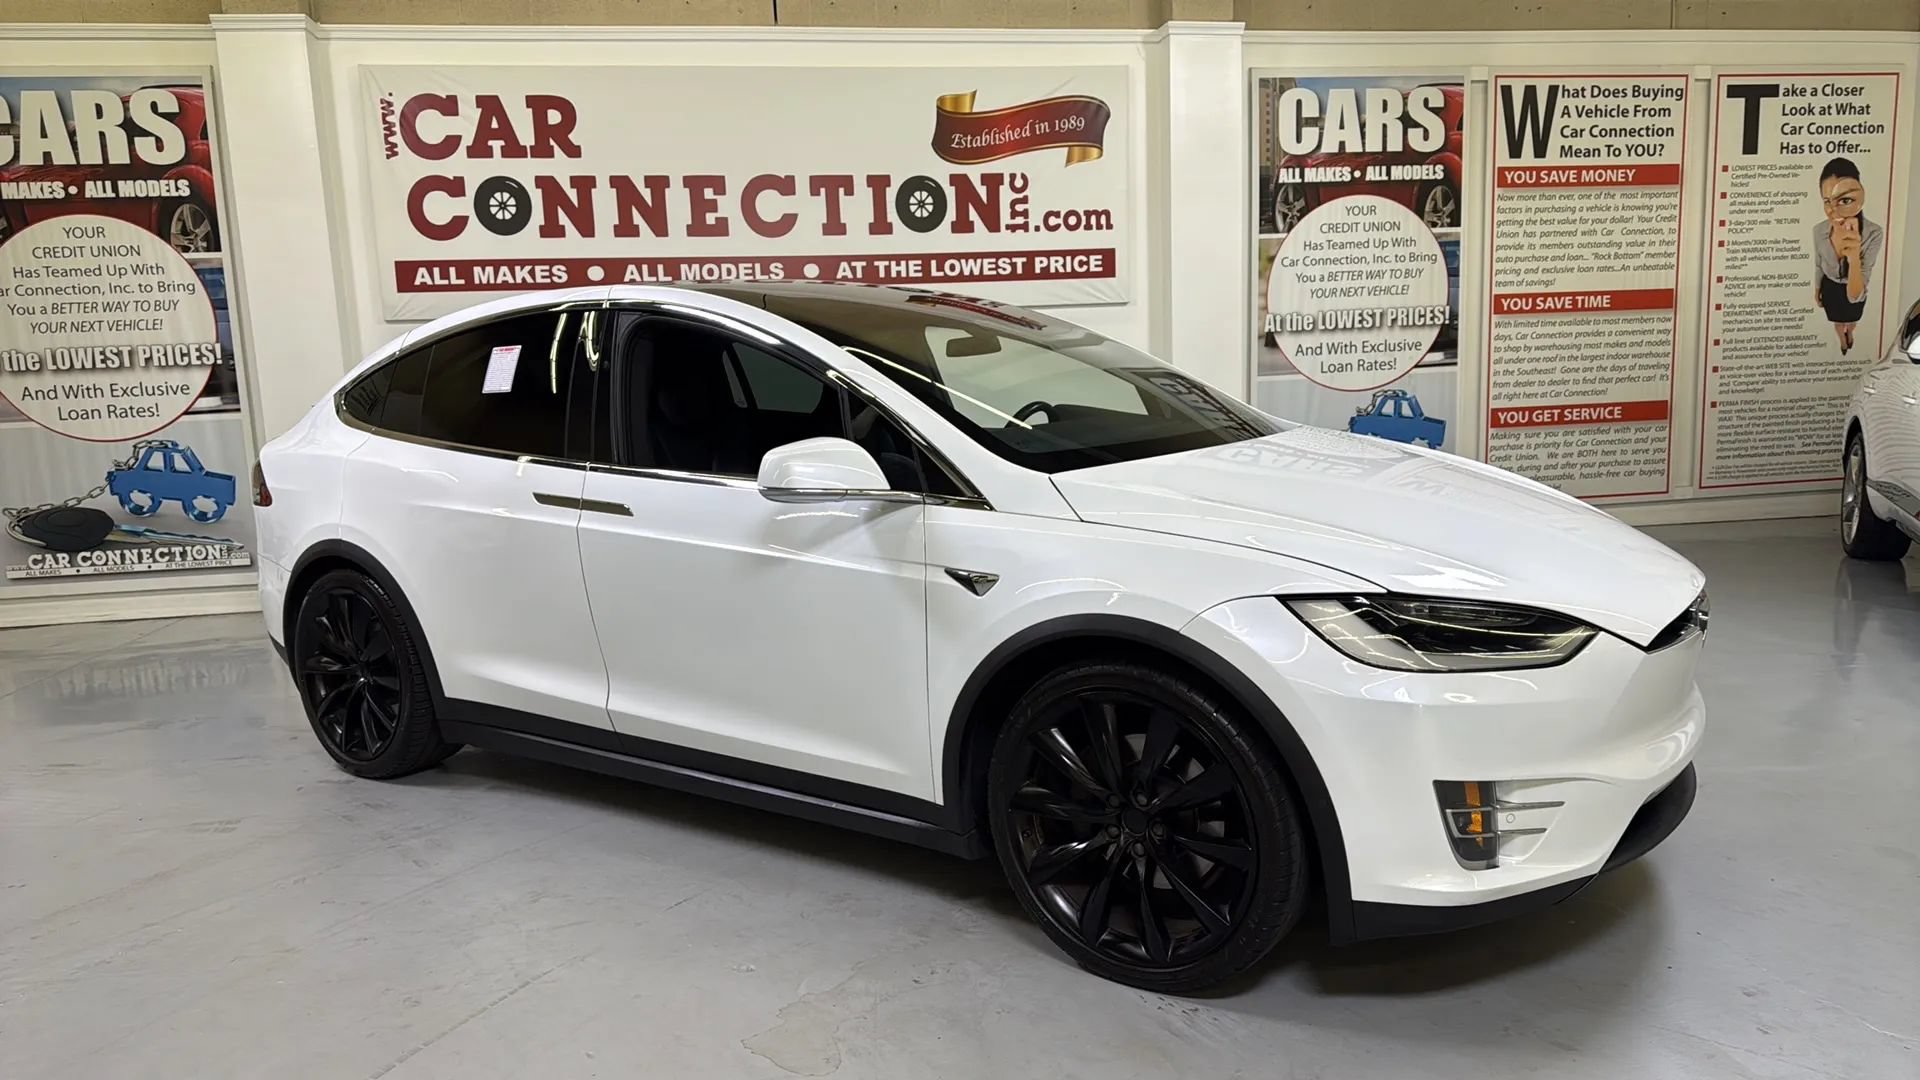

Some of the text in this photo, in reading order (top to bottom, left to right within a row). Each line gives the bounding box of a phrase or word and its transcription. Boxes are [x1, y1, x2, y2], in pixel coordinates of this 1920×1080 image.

[1590, 85, 1627, 98] Does
[1632, 84, 1684, 101] Buying
[1810, 88, 1818, 97] a
[1822, 84, 1864, 96] Closer
[1560, 105, 1671, 118] A Vehicle From
[1782, 102, 1871, 116] Look at What
[0, 88, 186, 166] ARS
[380, 92, 399, 160] www.
[399, 93, 582, 161] CAR
[1278, 87, 1445, 155] CARS
[1781, 121, 1884, 135] Car Connection
[951, 116, 1085, 148] Established in 1989
[1560, 124, 1674, 138] Car Connection
[1560, 143, 1664, 158] Mean To YOU?
[1780, 140, 1871, 155] Has to Offer...
[1279, 167, 1351, 183] ALL MAKES
[1365, 165, 1444, 181] ALL MODELS
[1504, 169, 1636, 183] YOU SAVE MONEY
[1, 180, 190, 199] MAKES ALL MODELS
[406, 173, 1004, 242] CONNECTION
[1345, 206, 1377, 216] YOUR
[1034, 208, 1113, 232] .com
[1320, 221, 1401, 233] CREDIT UNION
[62, 227, 105, 238] YOUR
[32, 245, 141, 259] CREDIT UNION
[1304, 237, 1416, 251] Has Teamed Up With
[836, 254, 1103, 279] AT THE LOWEST PRICE
[1281, 252, 1437, 267] Car Connection, Inc. to Bring
[13, 264, 164, 279] Has Teamed Up With
[414, 265, 568, 286] ALL MAKES
[623, 262, 784, 282] ALL MODELS
[1296, 273, 1316, 283] You
[1327, 271, 1363, 281] BETTER
[1365, 270, 1387, 280] WAY
[1390, 269, 1402, 279] TO
[1404, 268, 1424, 278] BUY
[15, 281, 195, 297] Connection, Inc. to Bring
[1310, 285, 1410, 299] YOUR NEXT VEHICLE!
[7, 299, 180, 316] You a BETTER WAY TO BUY
[1501, 295, 1611, 311] YOU SAVE TIME
[30, 319, 163, 334] YOUR NEXT VEHICLE!
[1264, 305, 1450, 333] At the LOWEST PRICES!
[1295, 339, 1422, 356] And With Exclusive
[2, 342, 222, 372] the LOWEST PRICES!
[1320, 358, 1397, 373] Loan Rates!
[22, 381, 190, 400] And With Exclusive
[58, 403, 160, 421] Loan Rates!
[1498, 407, 1622, 424] YOU GET SERVICE
[1490, 432, 1520, 441] Making
[1544, 431, 1559, 439] you
[1579, 428, 1611, 436] satisfied
[1614, 426, 1631, 434] with
[1634, 426, 1652, 435] your
[28, 553, 71, 569] CAR
[77, 544, 221, 567] CONNECTION
